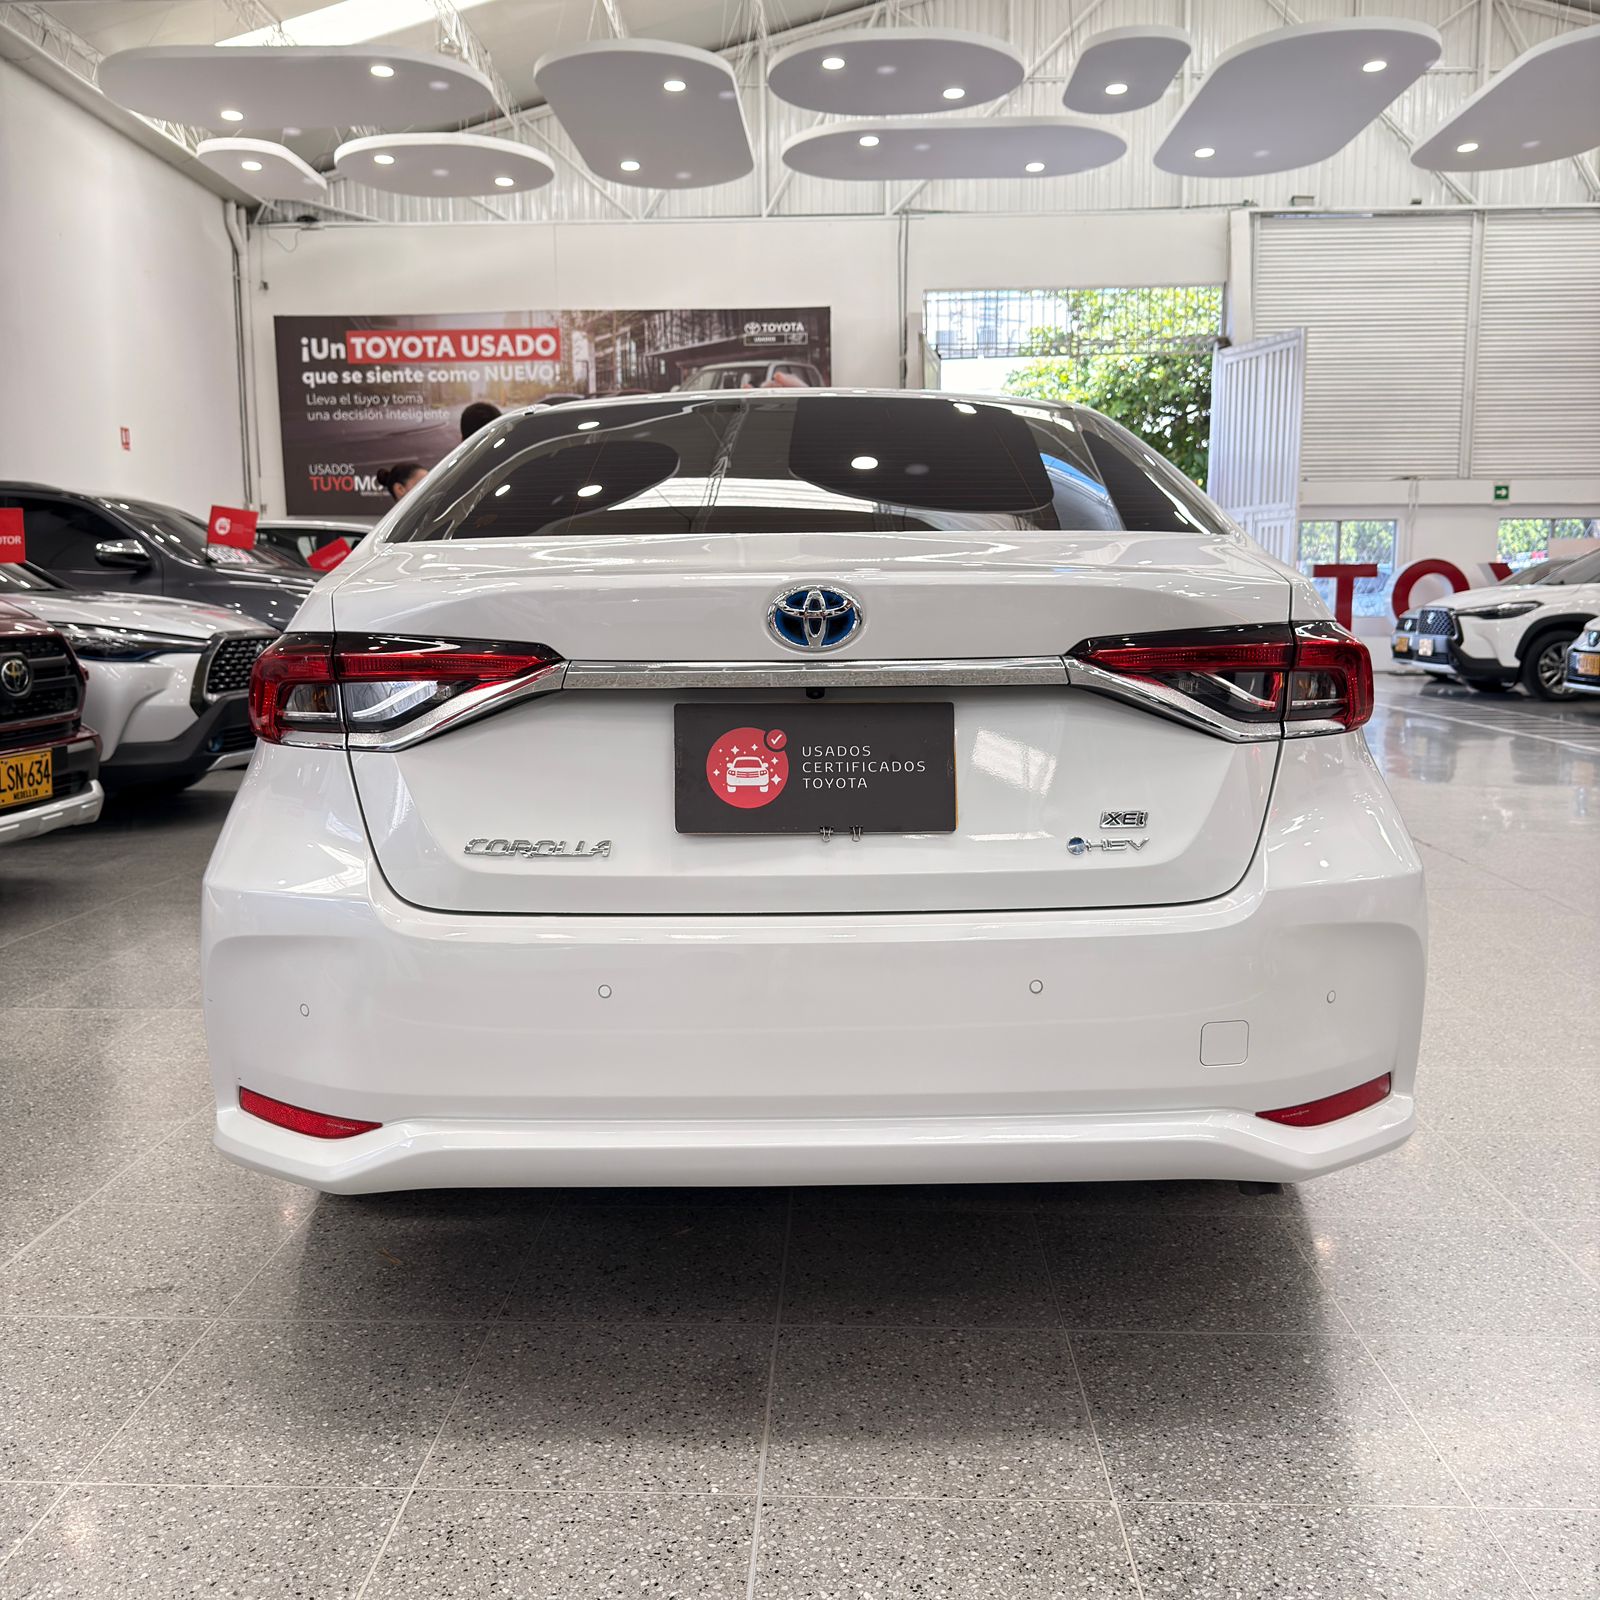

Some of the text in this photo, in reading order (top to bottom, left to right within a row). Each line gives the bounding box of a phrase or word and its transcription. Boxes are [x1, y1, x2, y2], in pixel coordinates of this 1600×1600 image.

[762, 322, 805, 332] TOYOTA
[301, 333, 557, 362] ¡Un TOYOTA USADO
[302, 363, 560, 389] que se siente como NUEVO!
[306, 393, 424, 408] Lleva el tuyo y toma
[307, 408, 450, 422] una decisión inteligente
[308, 463, 355, 475] USADOS
[0, 535, 22, 545] TOR
[802, 745, 872, 757] USADOS
[802, 760, 926, 773] CERTIFICADOS
[803, 777, 868, 789] TOYOTA
[464, 838, 612, 858] COROLLA
